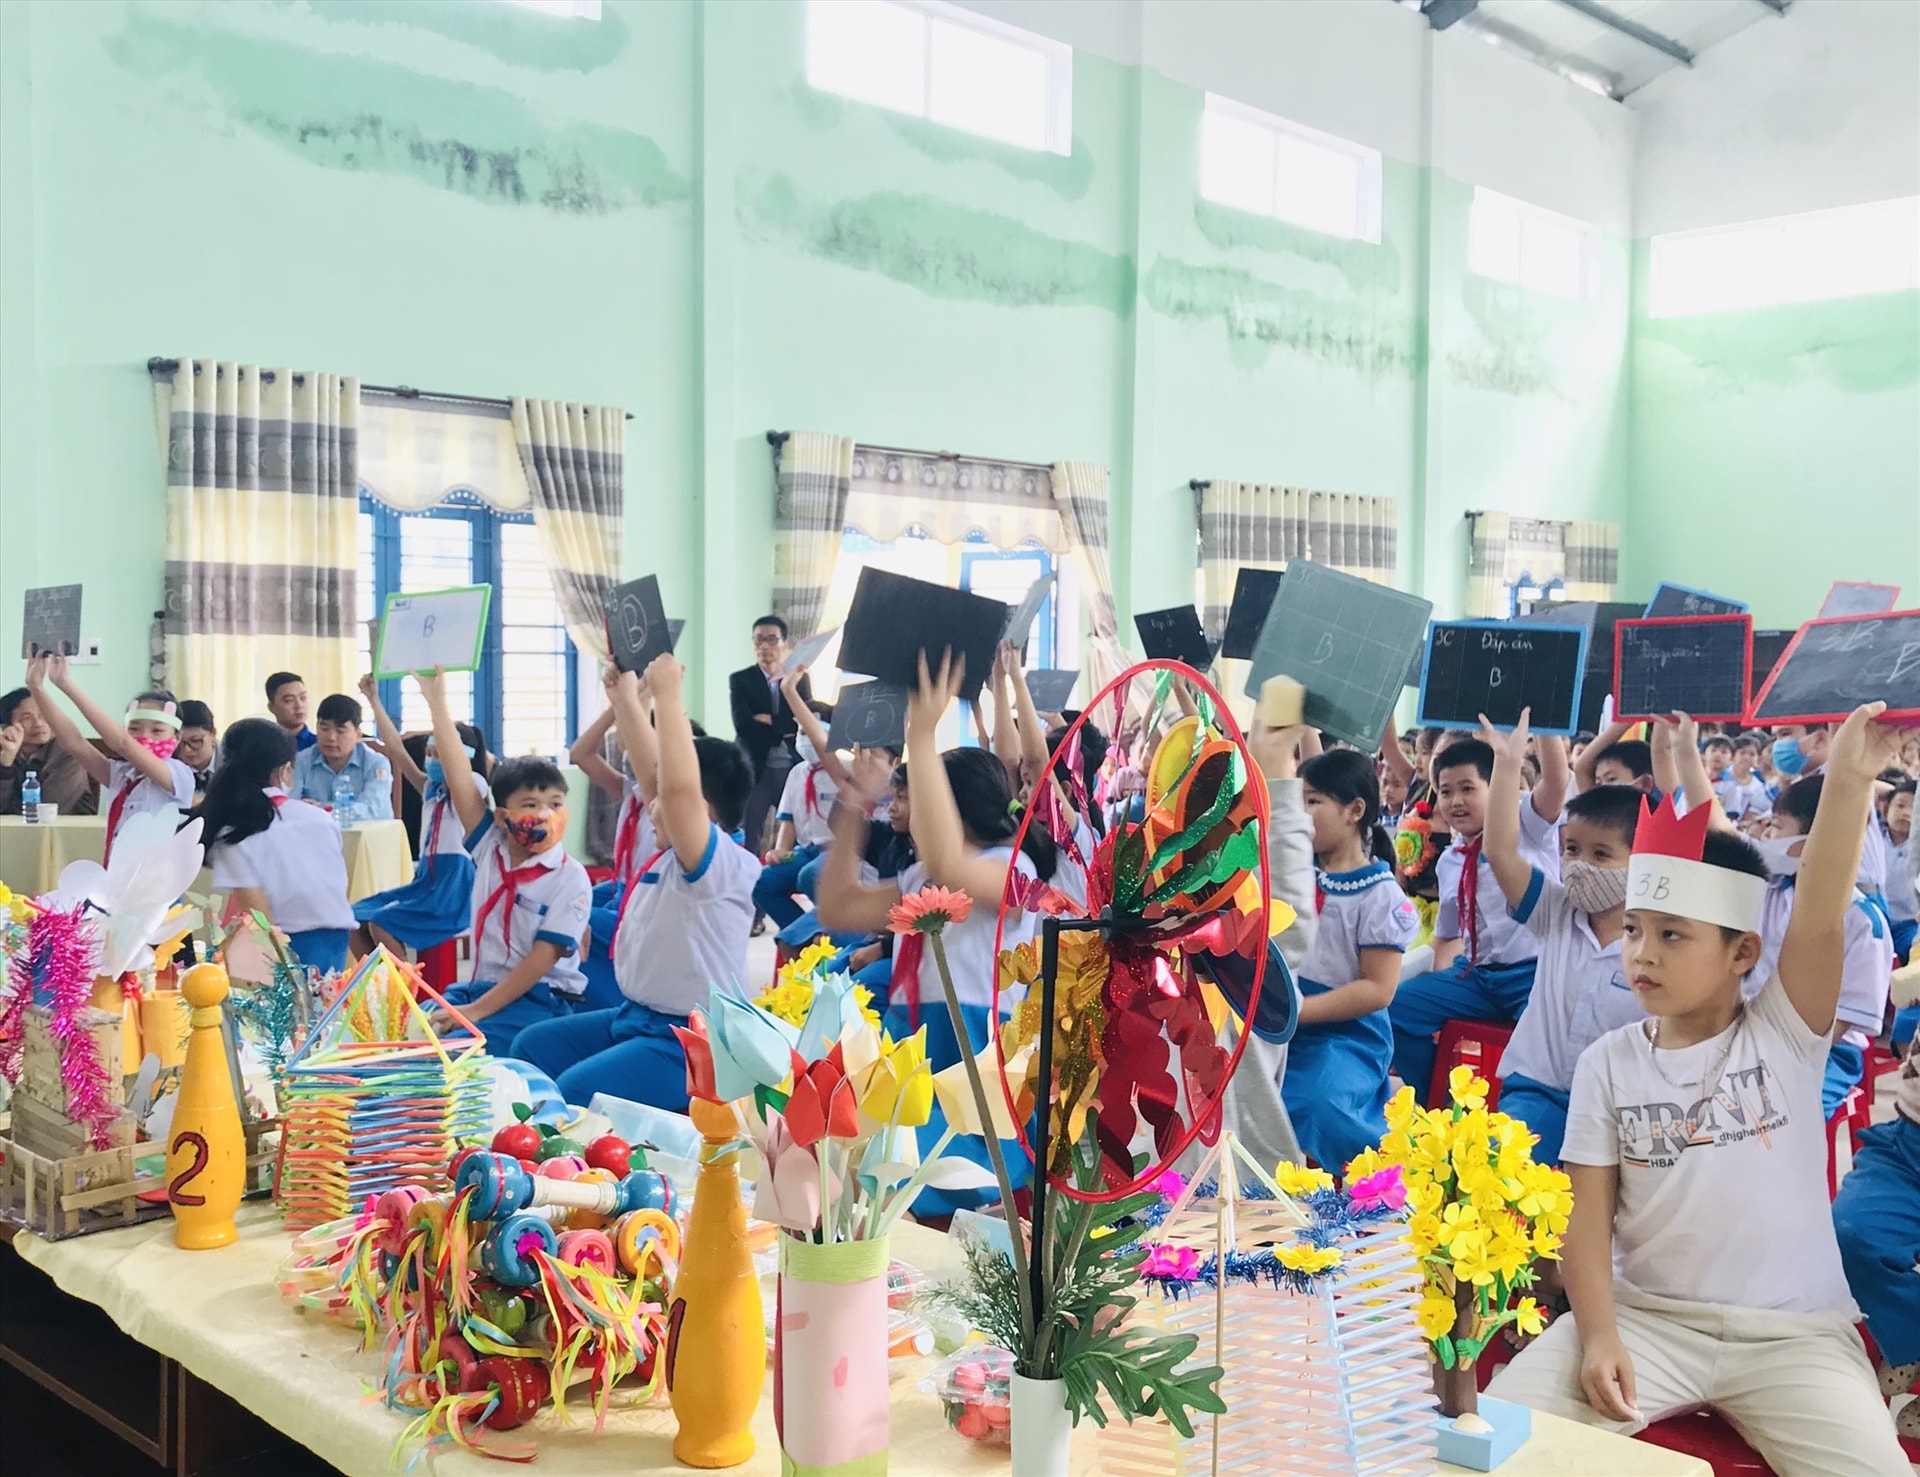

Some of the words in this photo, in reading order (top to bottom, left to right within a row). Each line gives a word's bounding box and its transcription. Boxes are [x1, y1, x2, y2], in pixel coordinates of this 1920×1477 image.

[423, 614, 437, 638] B
[623, 602, 645, 649] B
[1435, 629, 1455, 646] 3C
[1313, 632, 1334, 665] B
[1490, 667, 1502, 687] B
[1634, 873, 1671, 901] 3B
[168, 1131, 209, 1206] 2
[664, 1297, 687, 1393] 1
